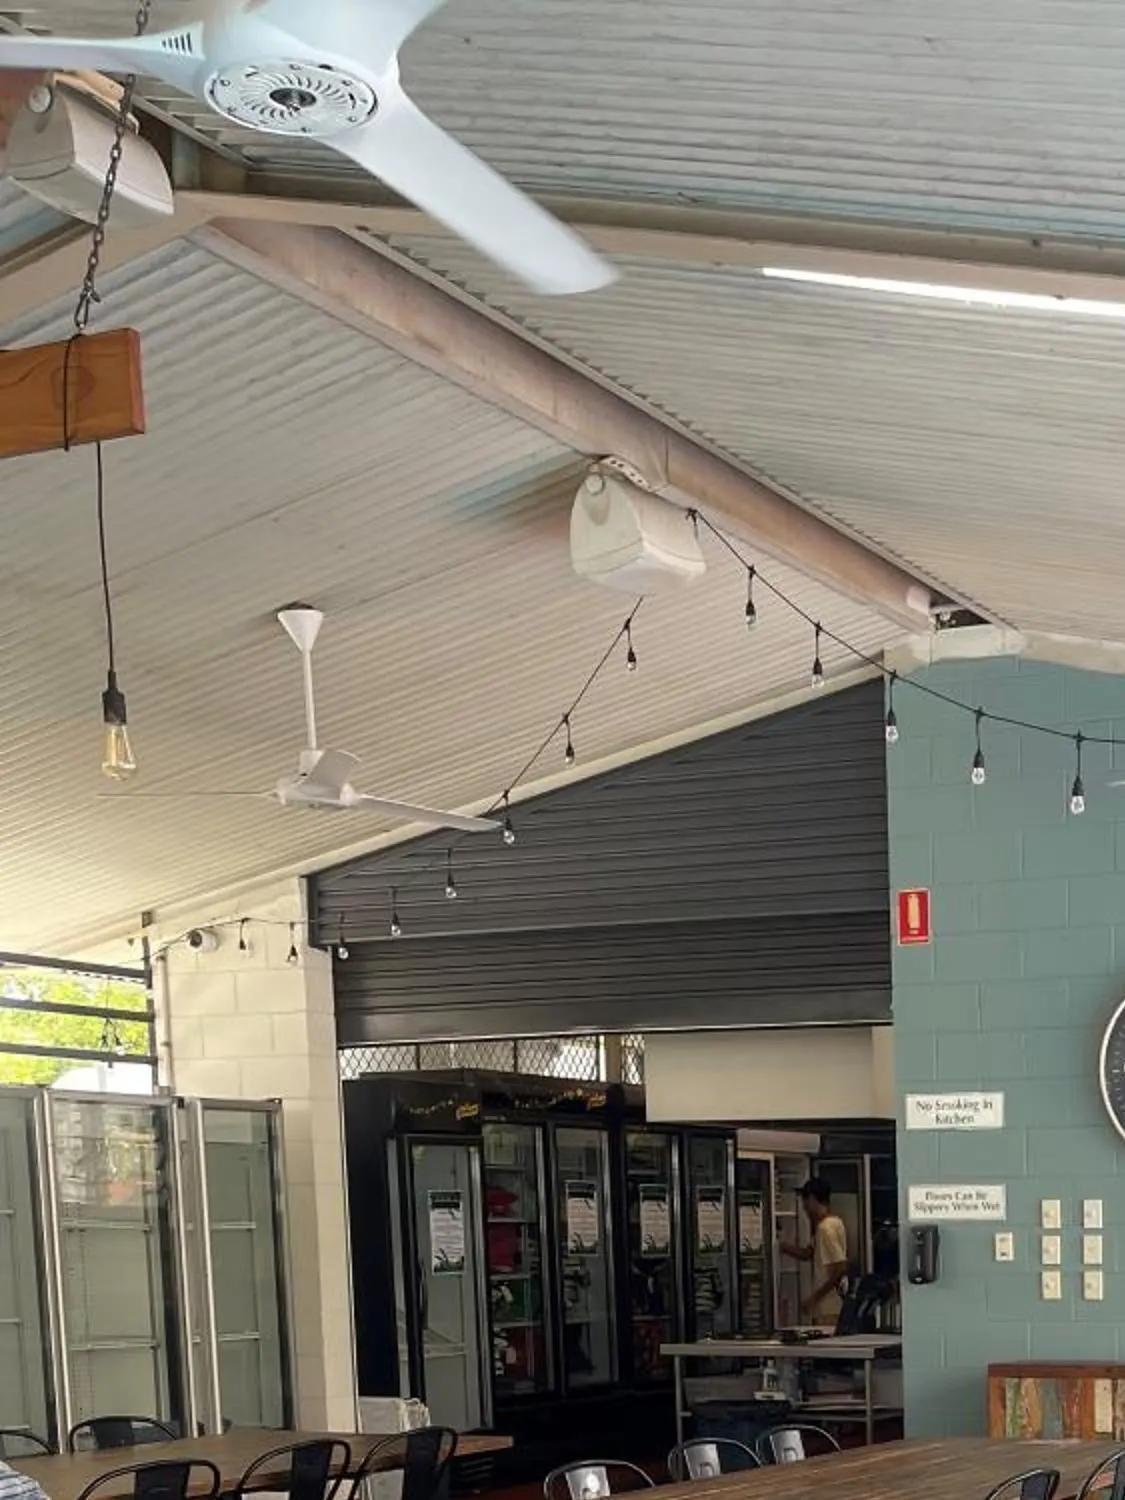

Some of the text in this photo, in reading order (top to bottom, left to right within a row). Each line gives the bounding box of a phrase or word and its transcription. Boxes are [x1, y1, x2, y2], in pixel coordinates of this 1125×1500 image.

[915, 1100, 933, 1112] No
[935, 1098, 981, 1112] Smoking
[935, 1113, 975, 1125] Kitchen
